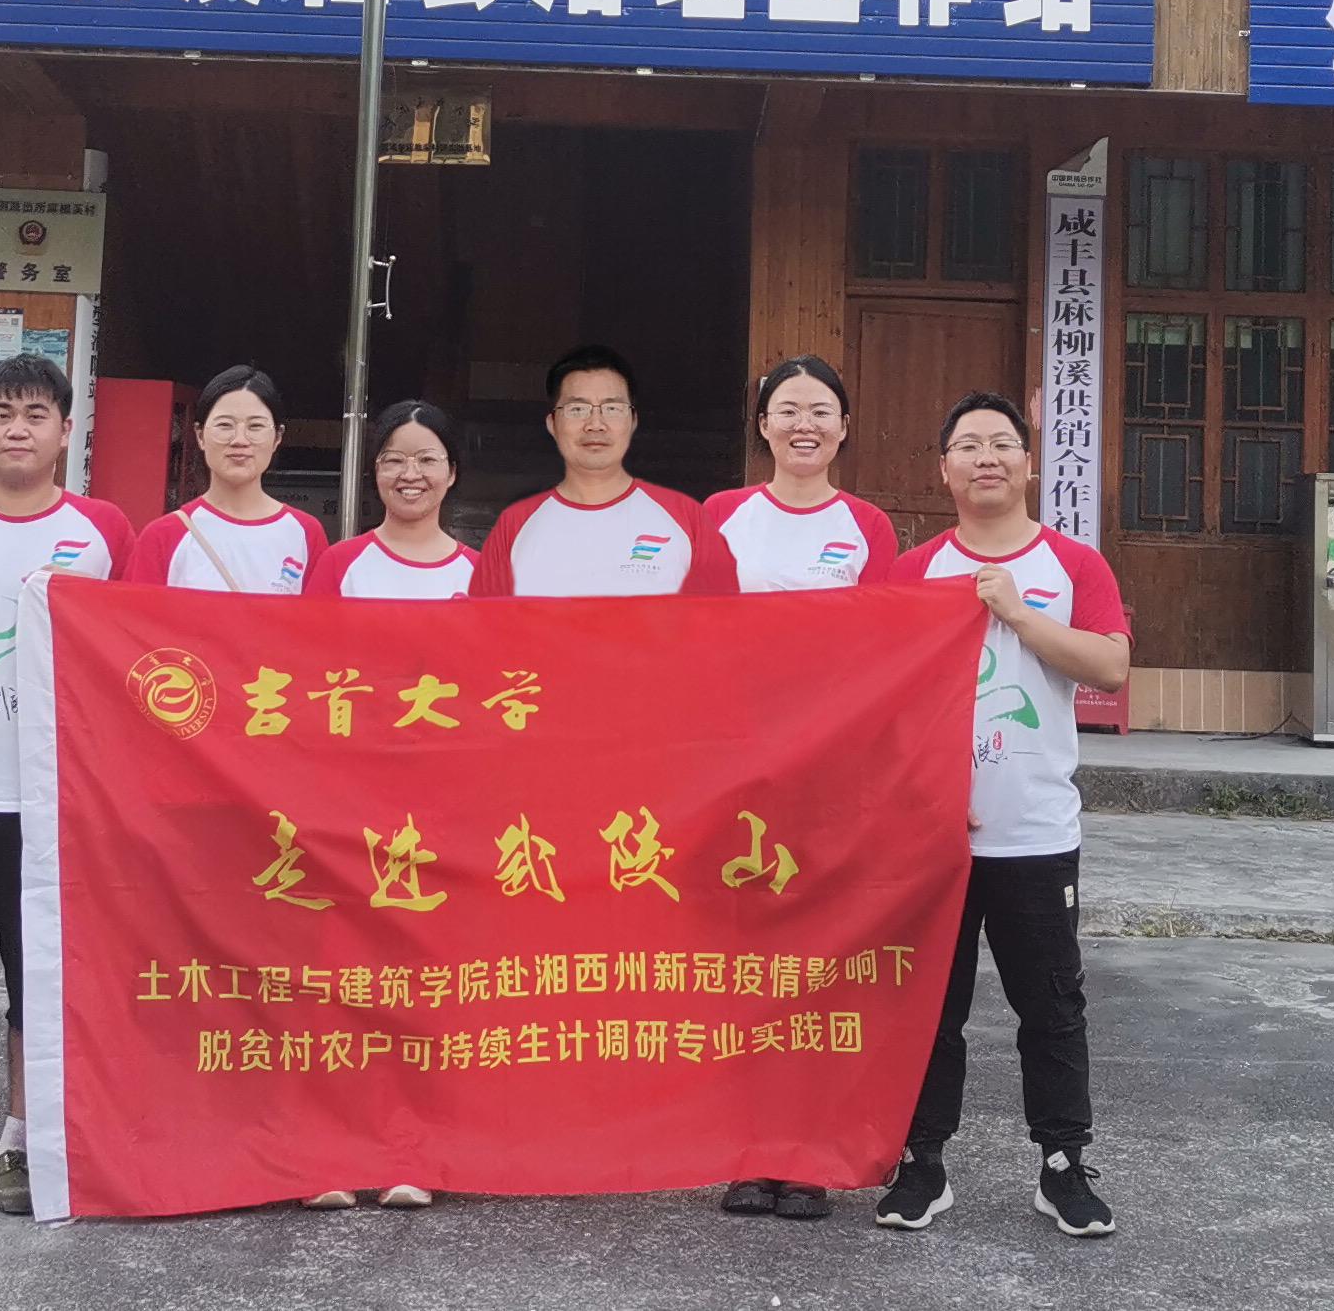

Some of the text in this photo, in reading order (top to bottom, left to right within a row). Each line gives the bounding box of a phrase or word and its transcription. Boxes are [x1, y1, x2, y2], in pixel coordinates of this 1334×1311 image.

[1049, 208, 1097, 540] 咸丰县麻柳溪供销合作社
[240, 665, 544, 737] 吉首大学
[252, 805, 800, 912] 走进武陵山
[136, 944, 915, 1009] 土木工程与建筑学院赴湘西州新冠疫情影响下
[197, 1010, 862, 1073] 脱贫村农户可持续生计调研专业实践团
